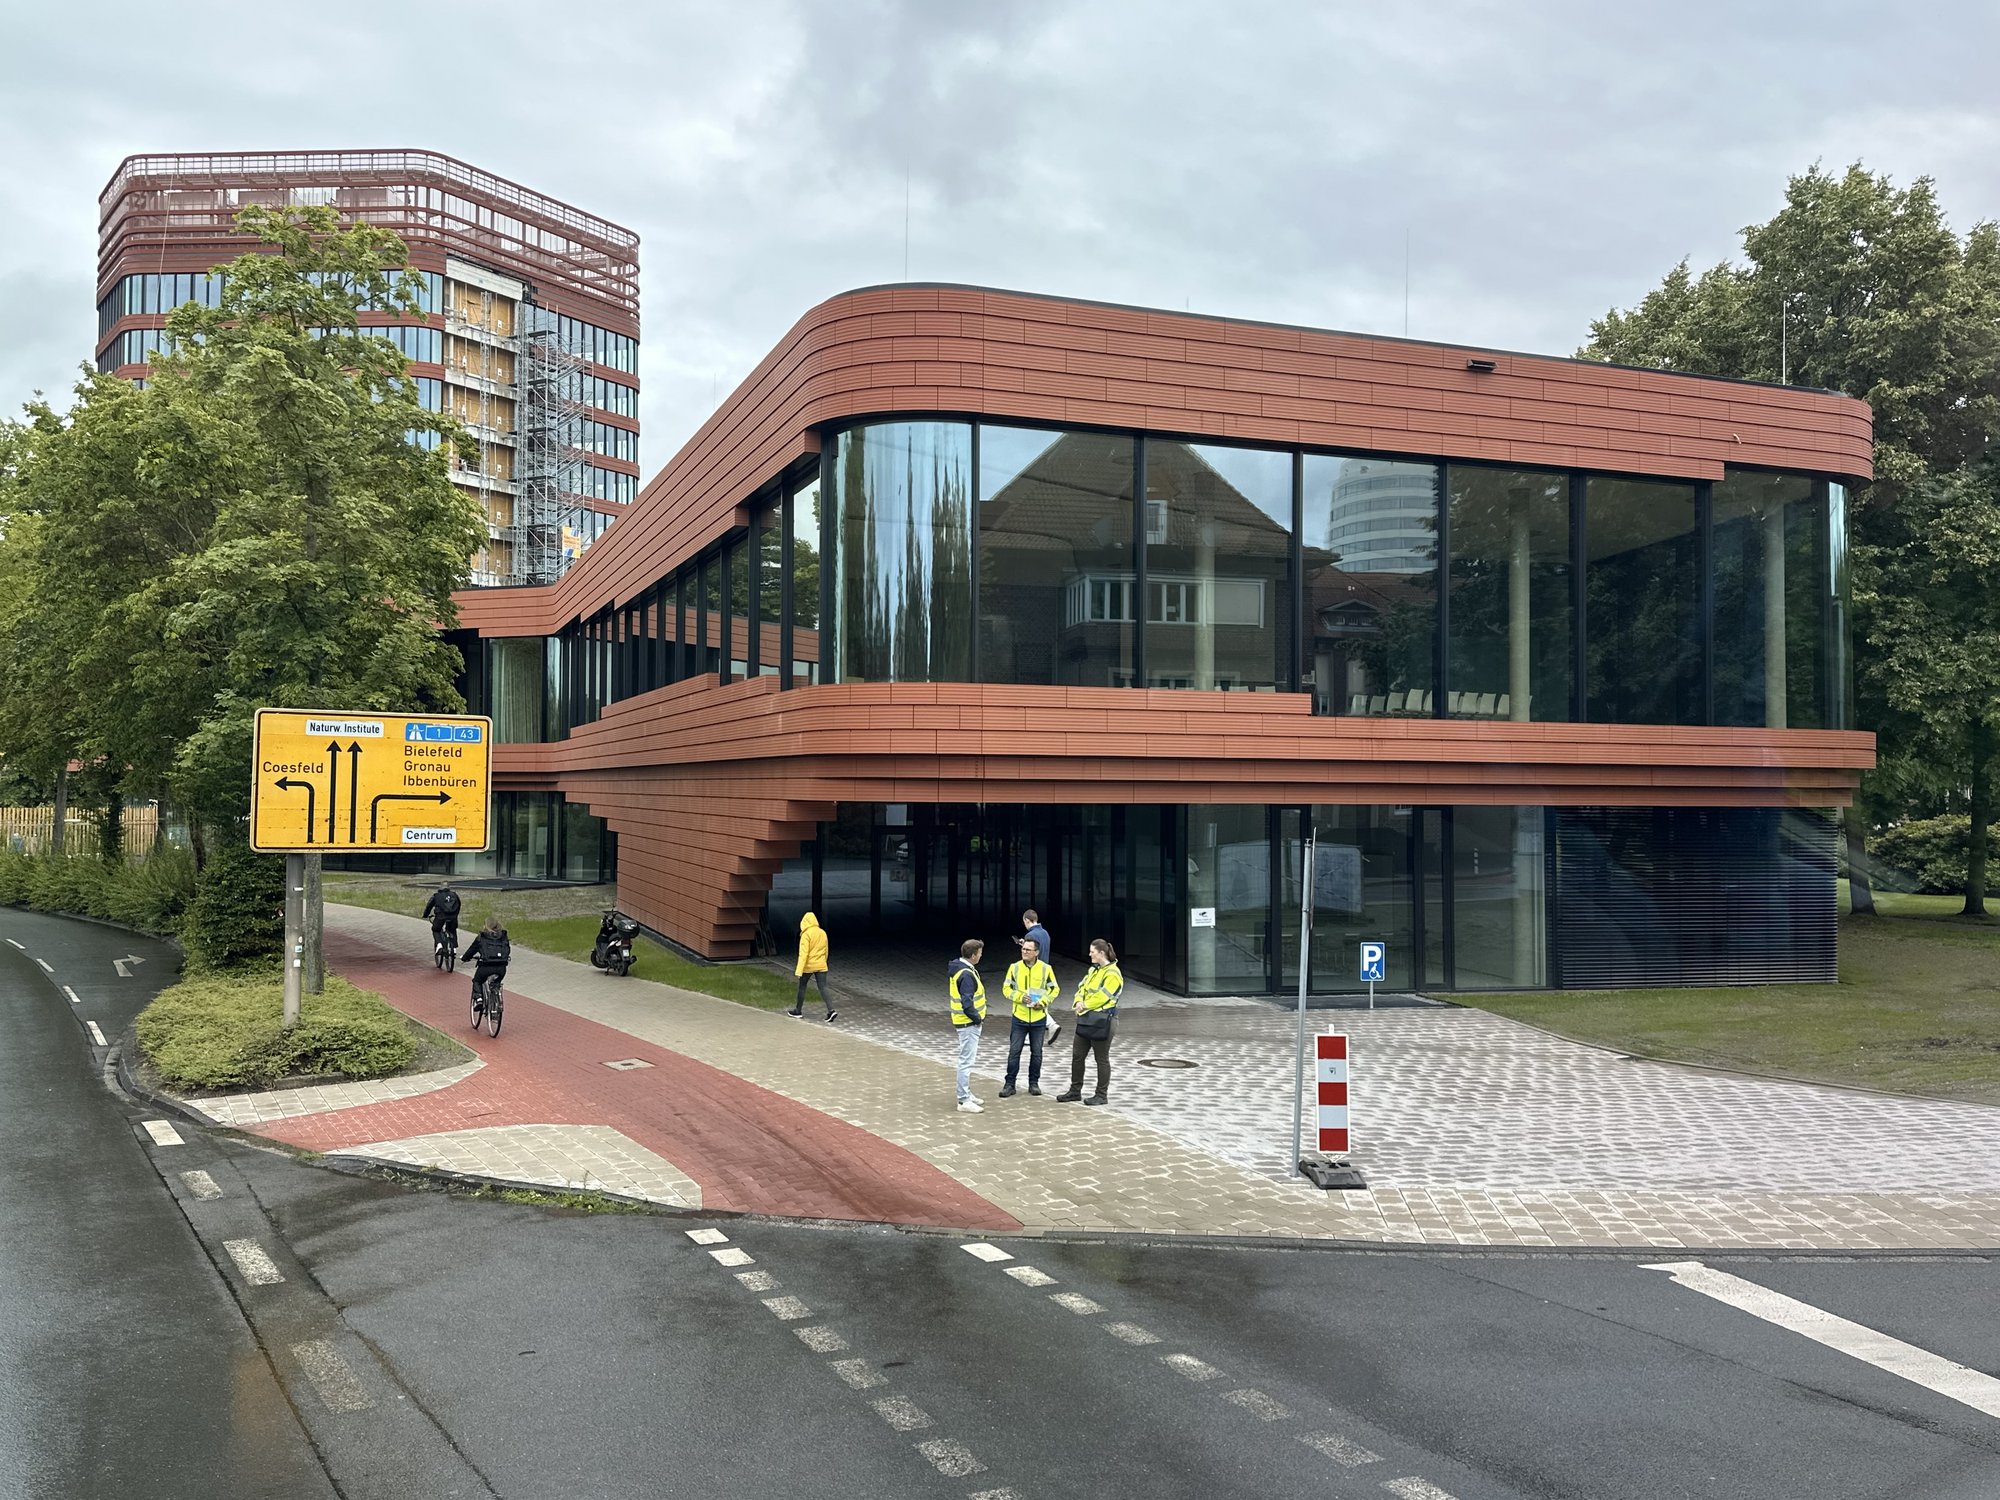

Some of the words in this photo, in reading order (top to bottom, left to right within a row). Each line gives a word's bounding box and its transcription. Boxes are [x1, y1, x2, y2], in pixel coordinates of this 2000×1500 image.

[310, 722, 342, 733] Naturw.
[344, 723, 380, 733] Institute
[436, 728, 441, 738] 1
[460, 729, 474, 739] 43
[404, 745, 462, 758] Bielefeld
[262, 761, 324, 774] Coesfeld
[404, 760, 451, 772] Gronau
[403, 775, 477, 788] Ibbenbüren
[406, 830, 453, 841] Centrum
[1363, 945, 1382, 971] P
